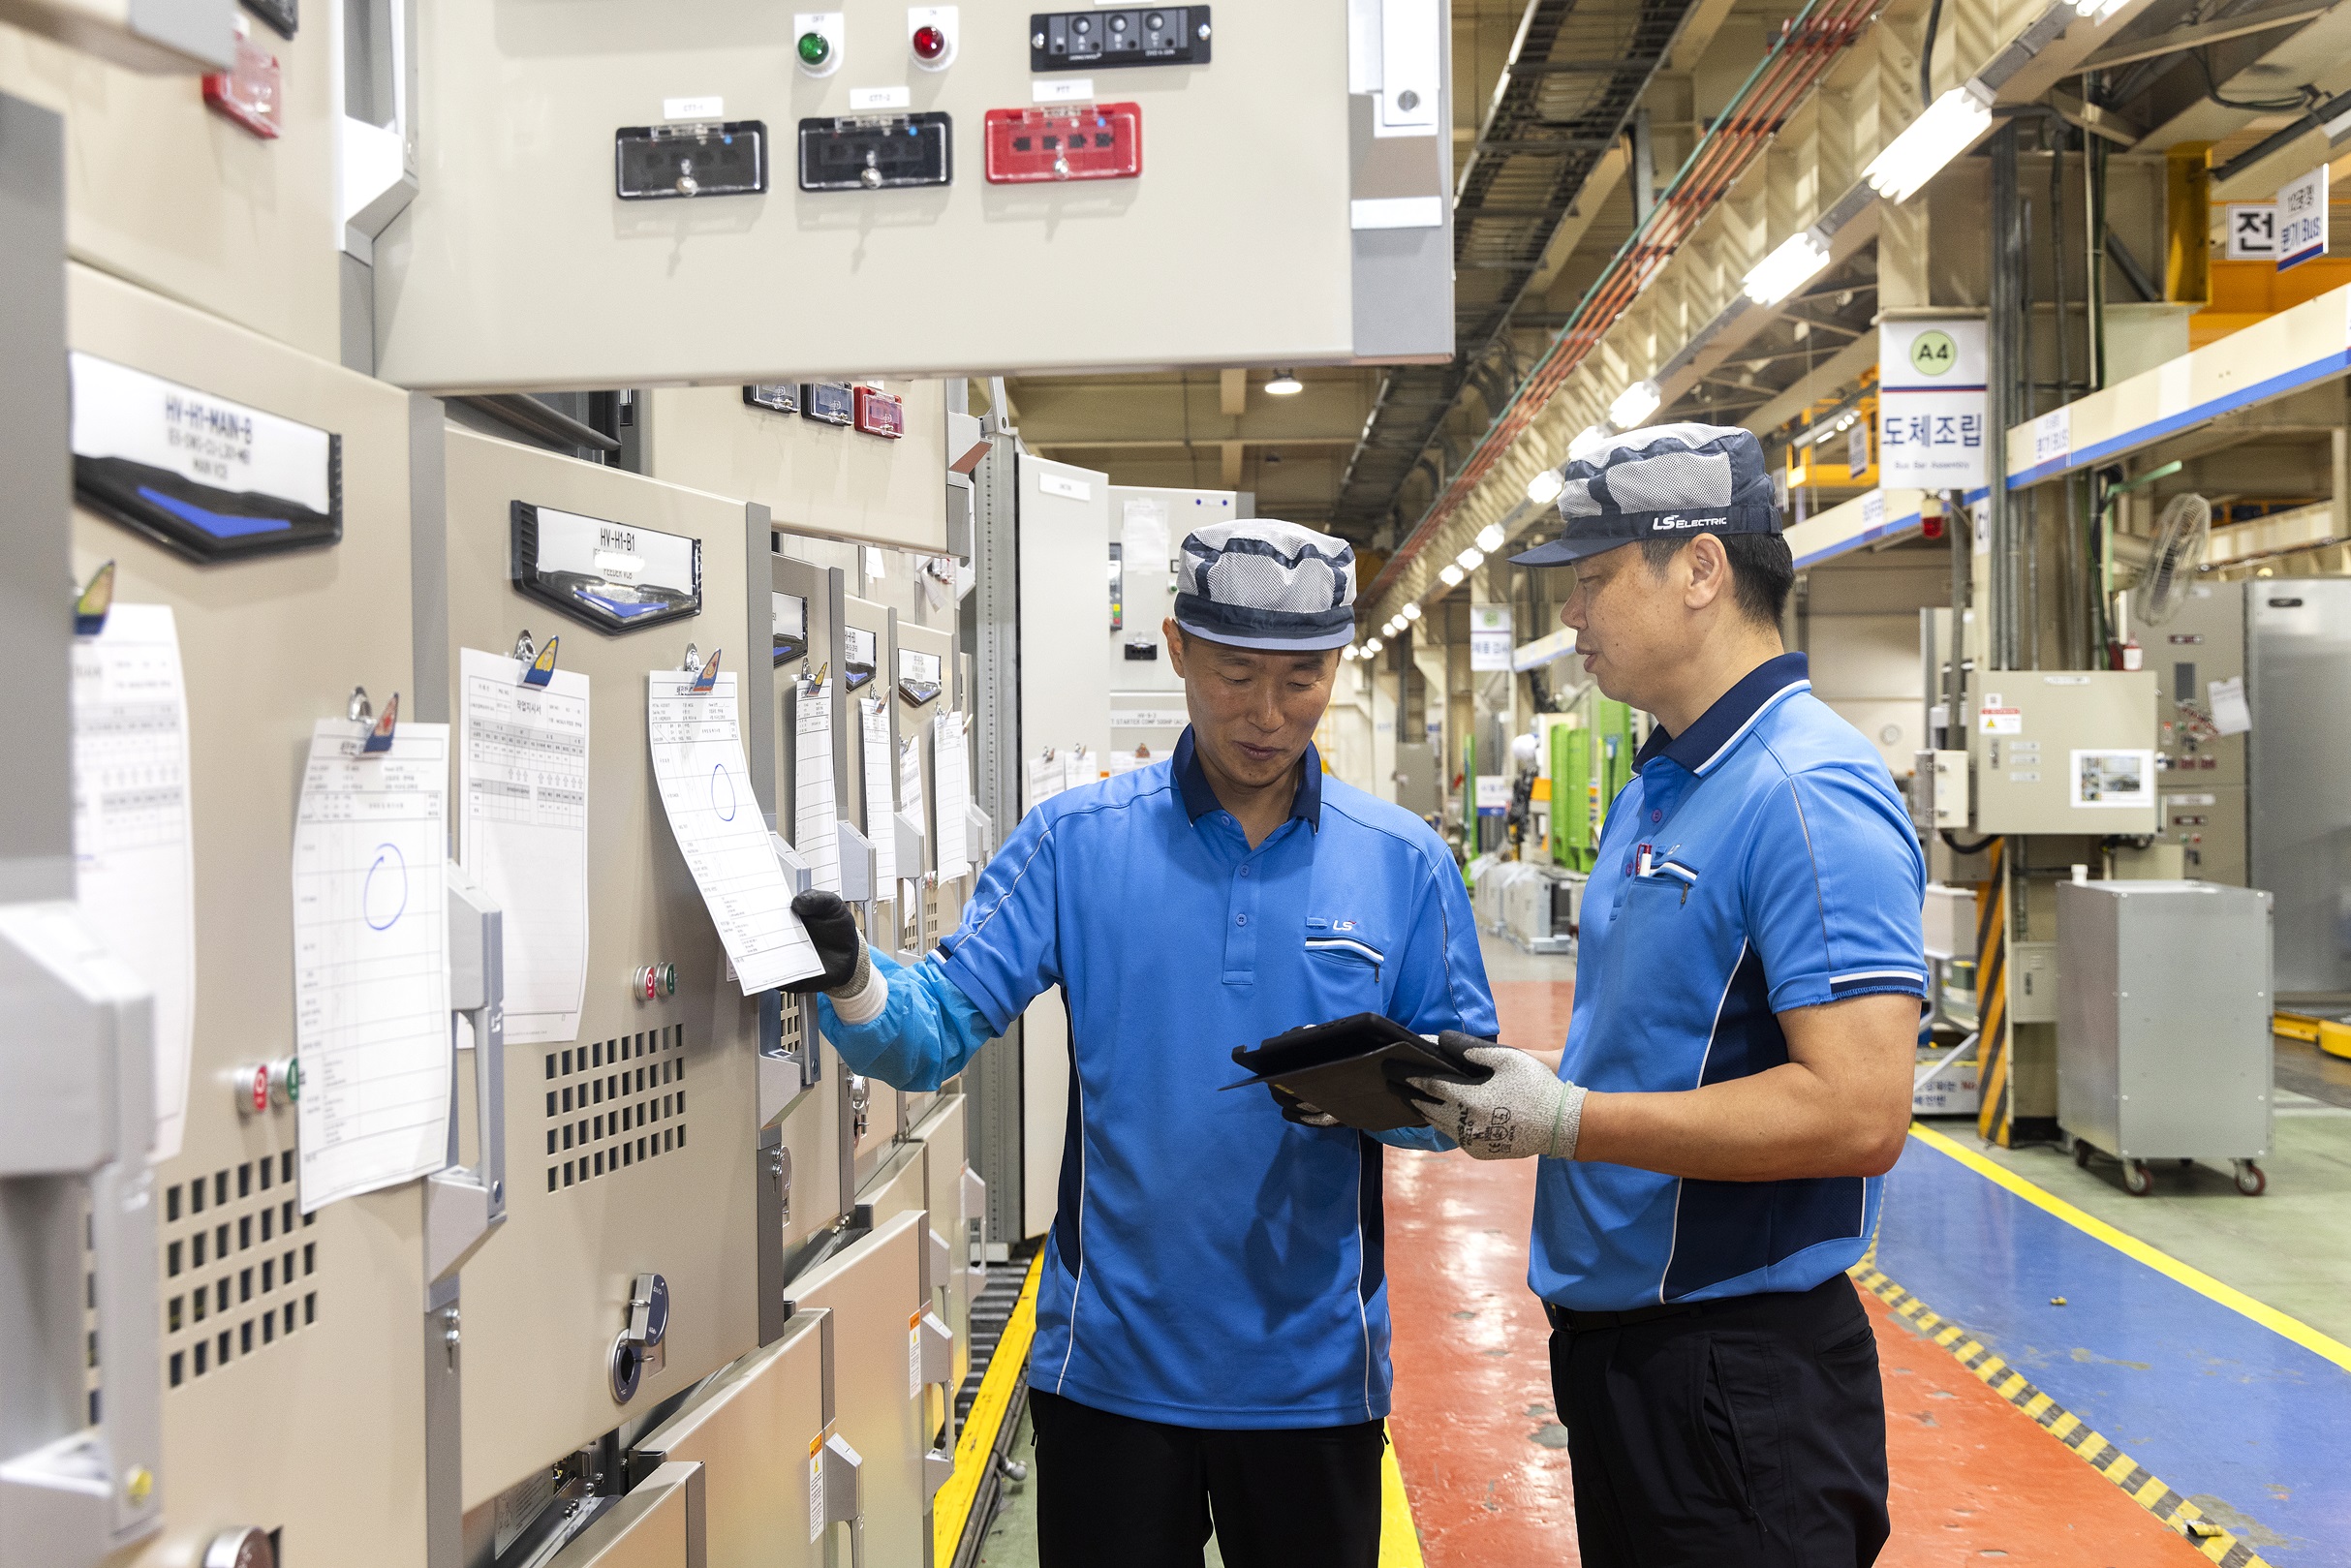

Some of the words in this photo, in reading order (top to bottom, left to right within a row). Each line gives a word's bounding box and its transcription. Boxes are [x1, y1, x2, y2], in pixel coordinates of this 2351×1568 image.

[2237, 211, 2274, 251] 전
[2302, 216, 2321, 242] BUS
[1917, 342, 1950, 361] A4
[1881, 414, 1983, 447] 도체조립
[1653, 514, 1680, 531] LS
[1676, 517, 1727, 529] ELECTRIC
[600, 527, 635, 552] HV-H1-B1
[1333, 919, 1356, 931] LS
